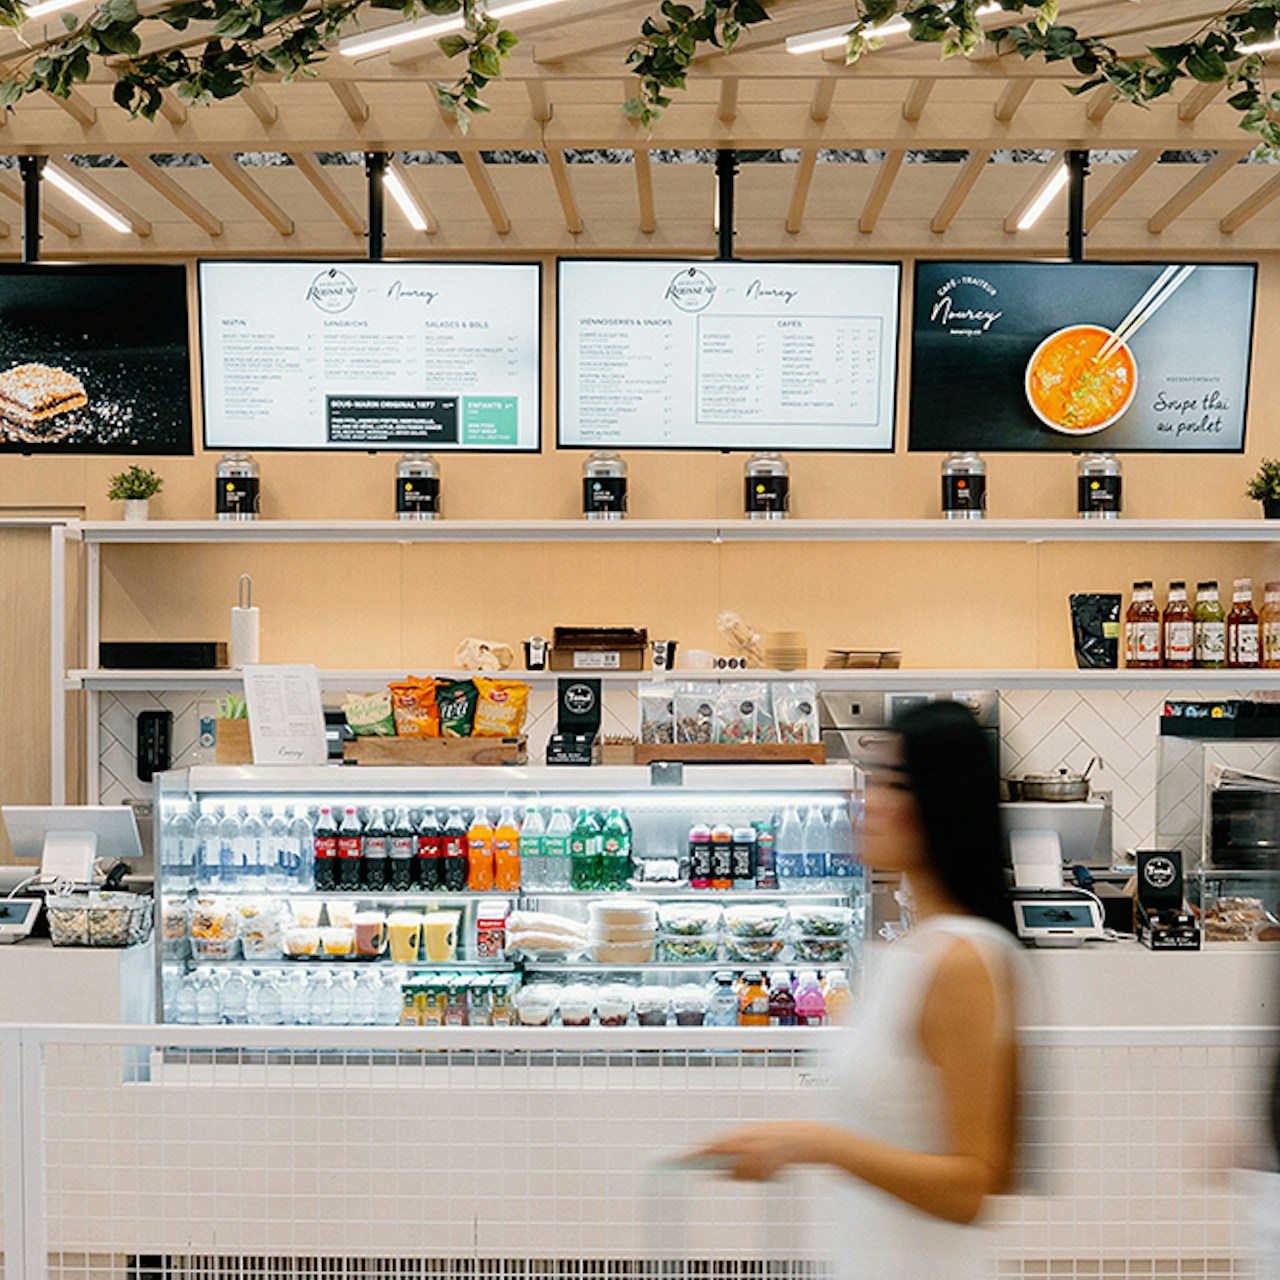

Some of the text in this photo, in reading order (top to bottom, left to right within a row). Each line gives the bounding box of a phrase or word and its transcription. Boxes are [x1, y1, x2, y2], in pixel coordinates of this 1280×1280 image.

[387, 280, 439, 304] Nourcy
[746, 279, 798, 303] Nourcy
[930, 296, 1002, 331] Nourcy
[1153, 391, 1197, 416] Soupe
[1156, 414, 1222, 437] au poulet
